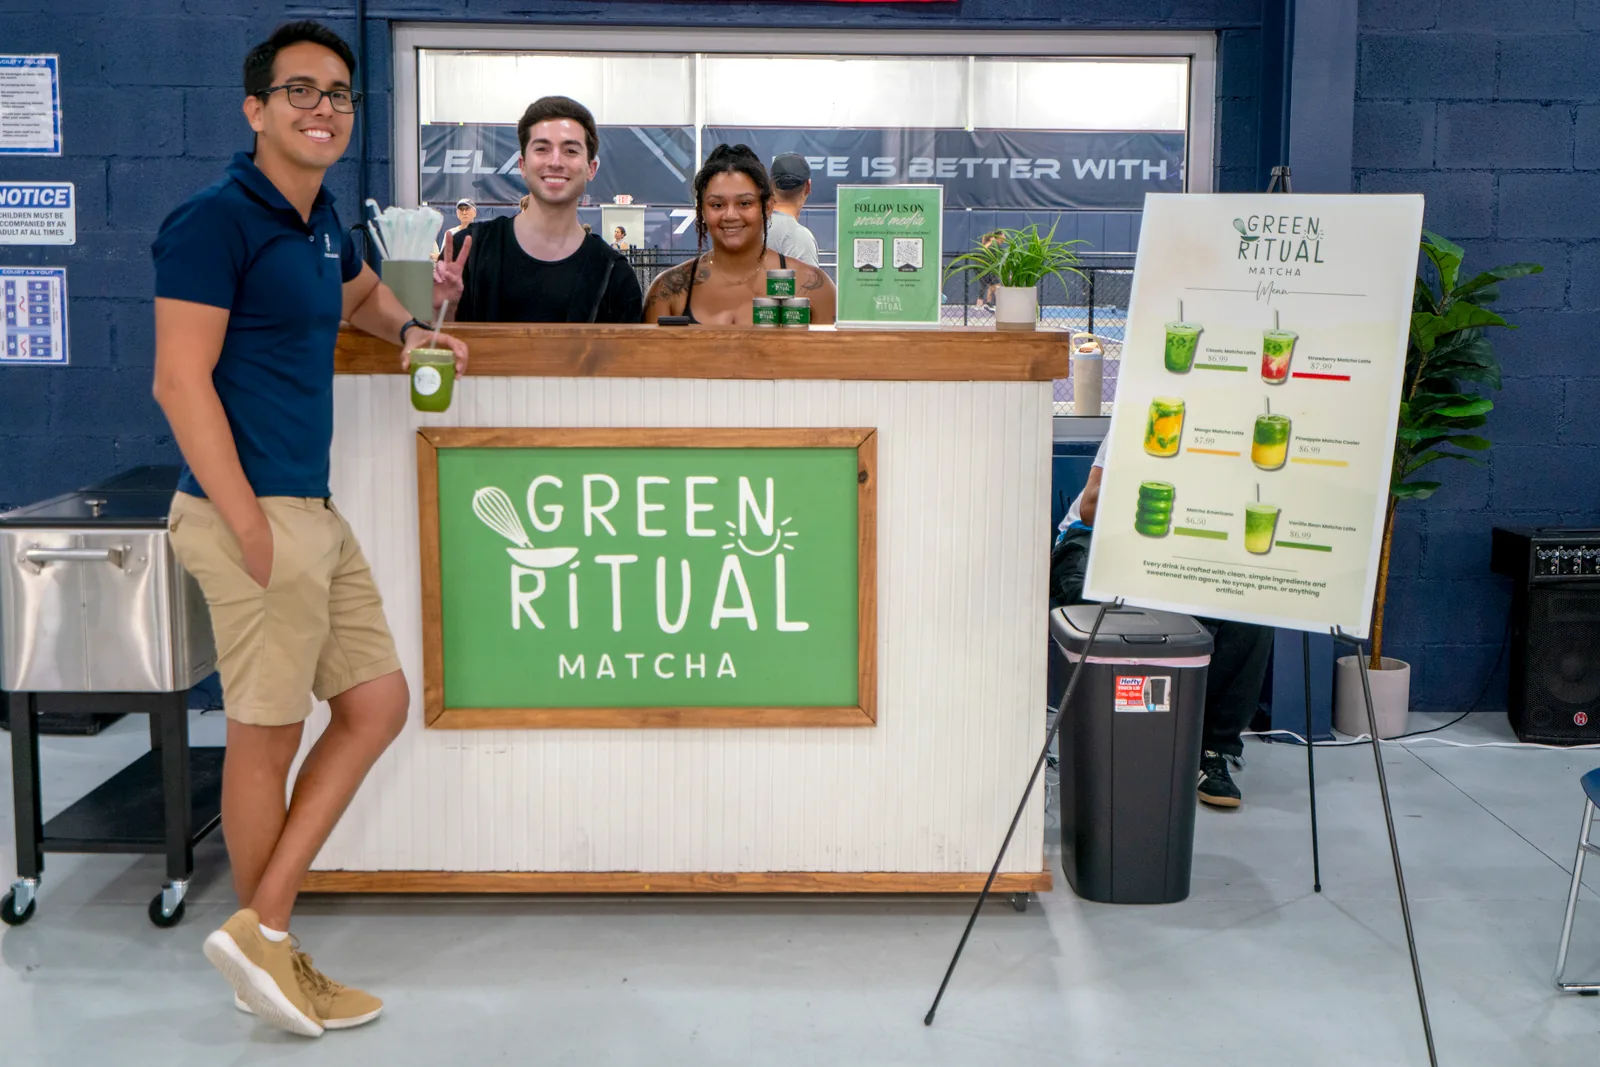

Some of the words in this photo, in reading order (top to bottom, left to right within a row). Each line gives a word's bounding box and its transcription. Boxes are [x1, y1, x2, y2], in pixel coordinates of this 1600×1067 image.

[861, 156, 897, 177] IS
[909, 157, 1061, 179] BETTER
[1072, 158, 1168, 180] WITH
[854, 203, 894, 214] FOLLOW
[896, 203, 909, 214] US
[910, 203, 925, 214] ON
[0, 220, 45, 228] CCOMPANIED
[47, 220, 56, 228] BY
[57, 220, 66, 228] AN
[669, 208, 697, 235] 7
[853, 209, 893, 227] social
[887, 211, 927, 229] media
[1247, 214, 1320, 235] GREEN
[20, 228, 28, 236] AT
[29, 228, 41, 236] ALL
[42, 228, 64, 236] TIMES
[1248, 266, 1301, 277] MATCHA
[1256, 280, 1289, 306] Menu
[1307, 355, 1336, 363] Strawberry
[1310, 361, 1333, 370] $7.99
[526, 474, 775, 538] GREEN
[1206, 509, 1235, 517] Americano
[1288, 519, 1308, 527] Vanilla
[1322, 523, 1343, 531] Matcha
[1289, 529, 1312, 540] $6.99
[1143, 560, 1161, 569] Every
[1162, 562, 1179, 570] drink
[1187, 565, 1211, 574] crafted
[1211, 568, 1227, 576] with
[1227, 571, 1247, 579] clean,
[1248, 573, 1272, 582] simple
[1272, 576, 1312, 587] ingredients
[1312, 581, 1326, 589] and
[1146, 569, 1182, 579] sweetened
[1183, 573, 1198, 581] with
[1198, 576, 1221, 584] agave.
[1222, 578, 1232, 586] No
[1232, 580, 1257, 589] syrups,
[1257, 583, 1279, 591] gums,
[1288, 587, 1321, 598] anything
[1215, 586, 1246, 596] artificial.
[558, 652, 738, 680] MATCHA
[1120, 678, 1141, 686] Hefty
